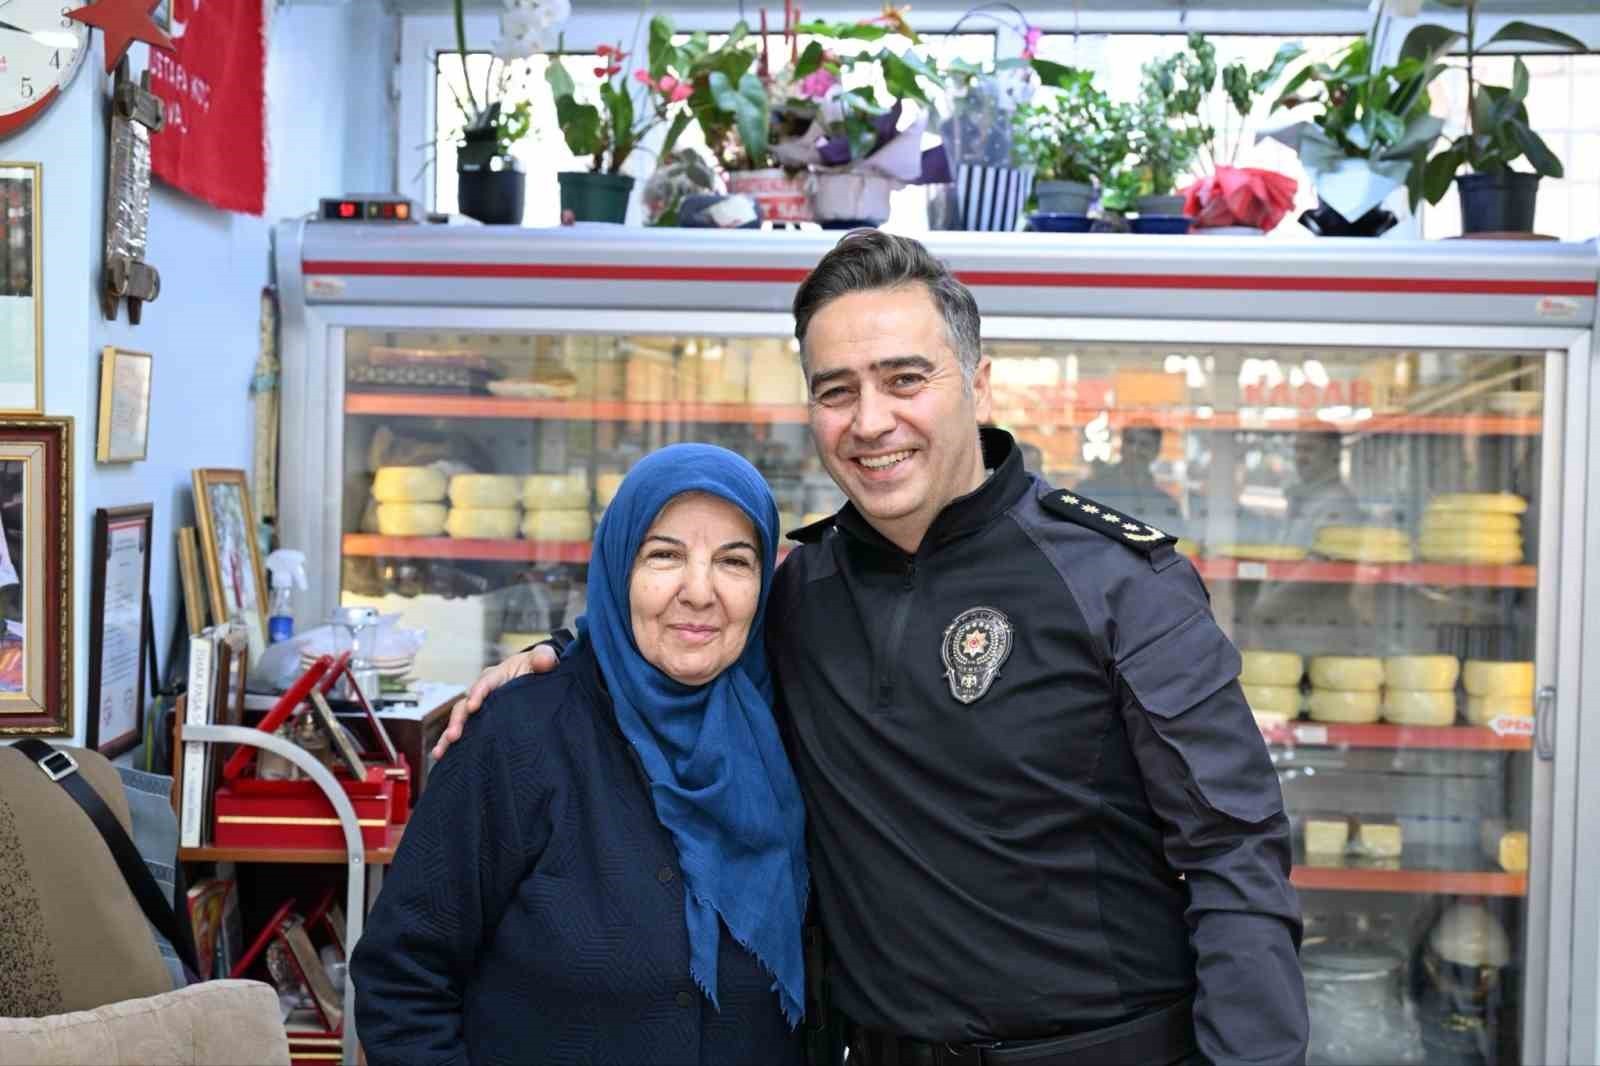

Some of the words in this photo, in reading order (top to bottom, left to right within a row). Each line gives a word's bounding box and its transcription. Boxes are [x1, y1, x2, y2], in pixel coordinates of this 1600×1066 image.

[48, 48, 62, 70] 4
[21, 77, 33, 97] 5
[1496, 719, 1535, 730] OPEN
